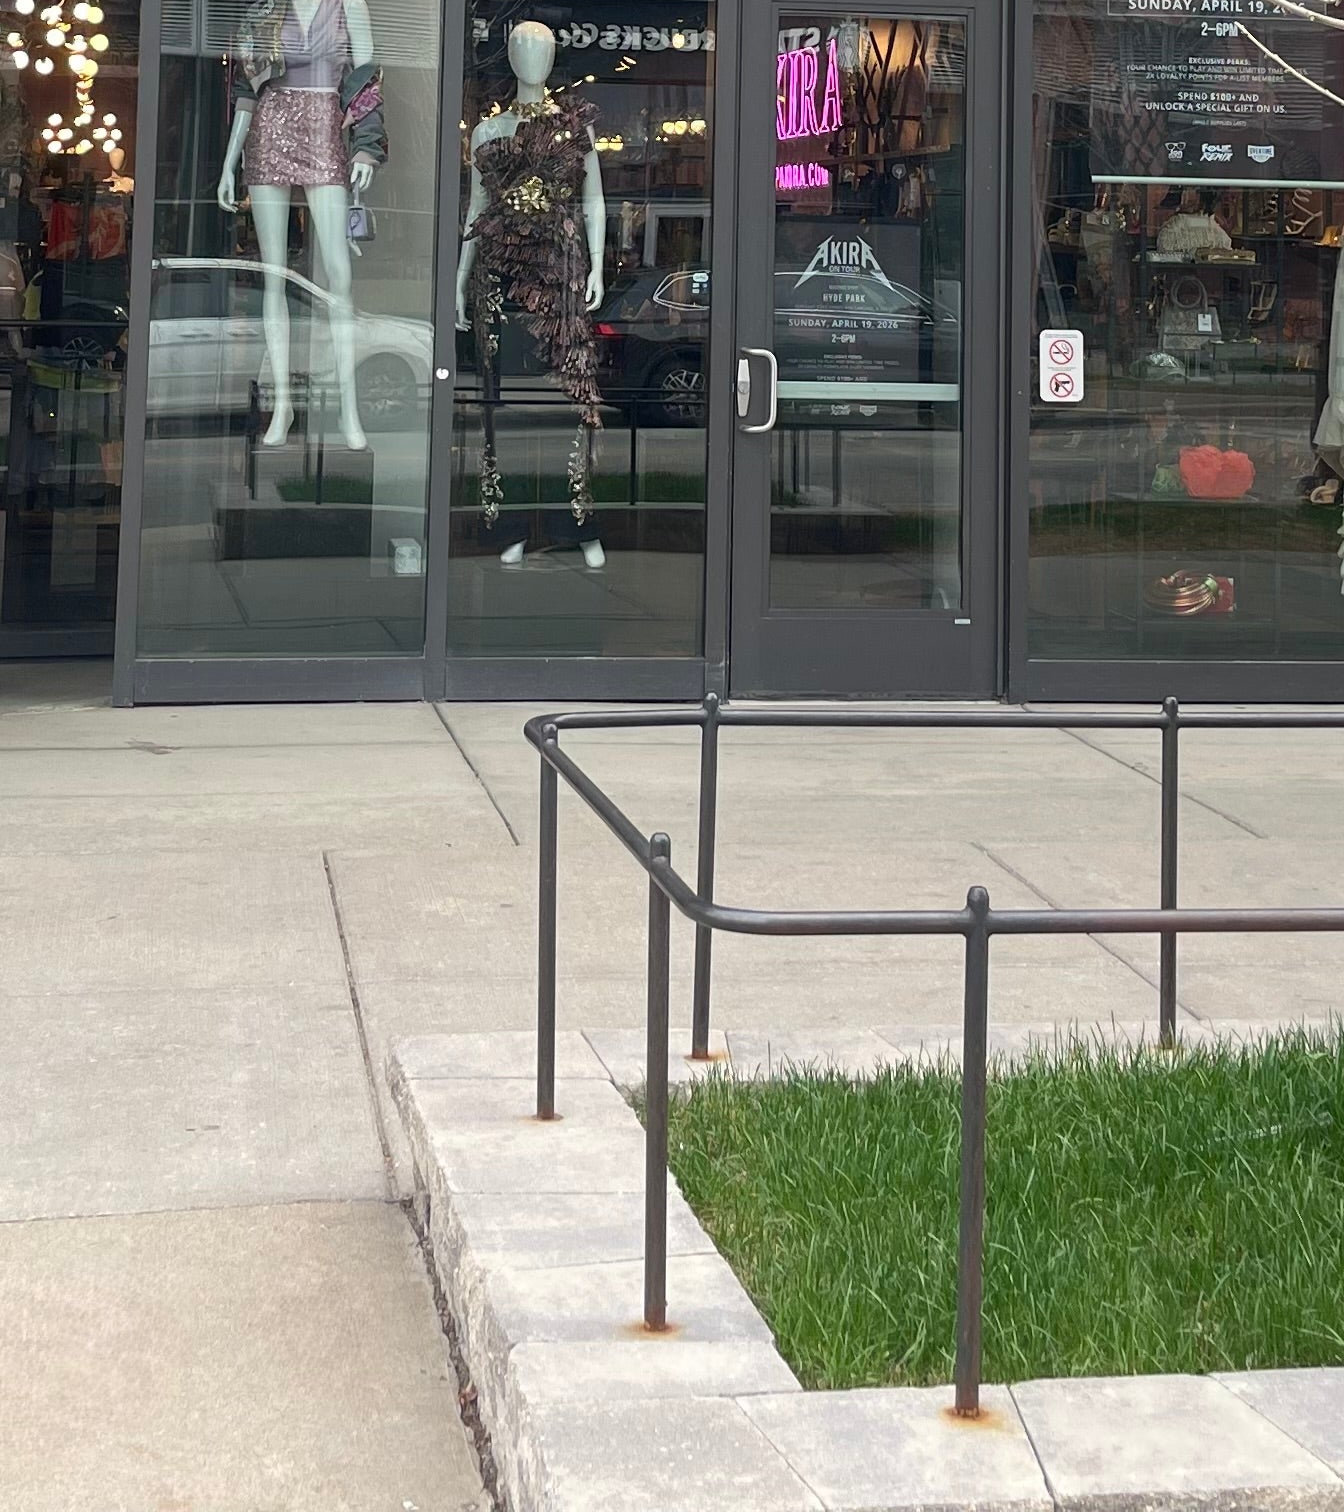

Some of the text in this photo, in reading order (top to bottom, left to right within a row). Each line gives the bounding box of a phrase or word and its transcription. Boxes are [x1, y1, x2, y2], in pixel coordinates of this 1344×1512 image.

[1248, 0, 1268, 15] 19,
[1177, 92, 1208, 101] SPEND
[1238, 94, 1260, 102] AND
[1145, 102, 1185, 111] UNLOCK
[1186, 103, 1194, 111] A
[1196, 103, 1232, 112] SPECIAL
[1234, 104, 1254, 112] GIFT
[1257, 104, 1271, 113] ON
[792, 235, 895, 292] AKIRA
[823, 293, 866, 304] HYDE PARK
[788, 318, 829, 329] SUNDAY,
[831, 319, 859, 329] APRIL
